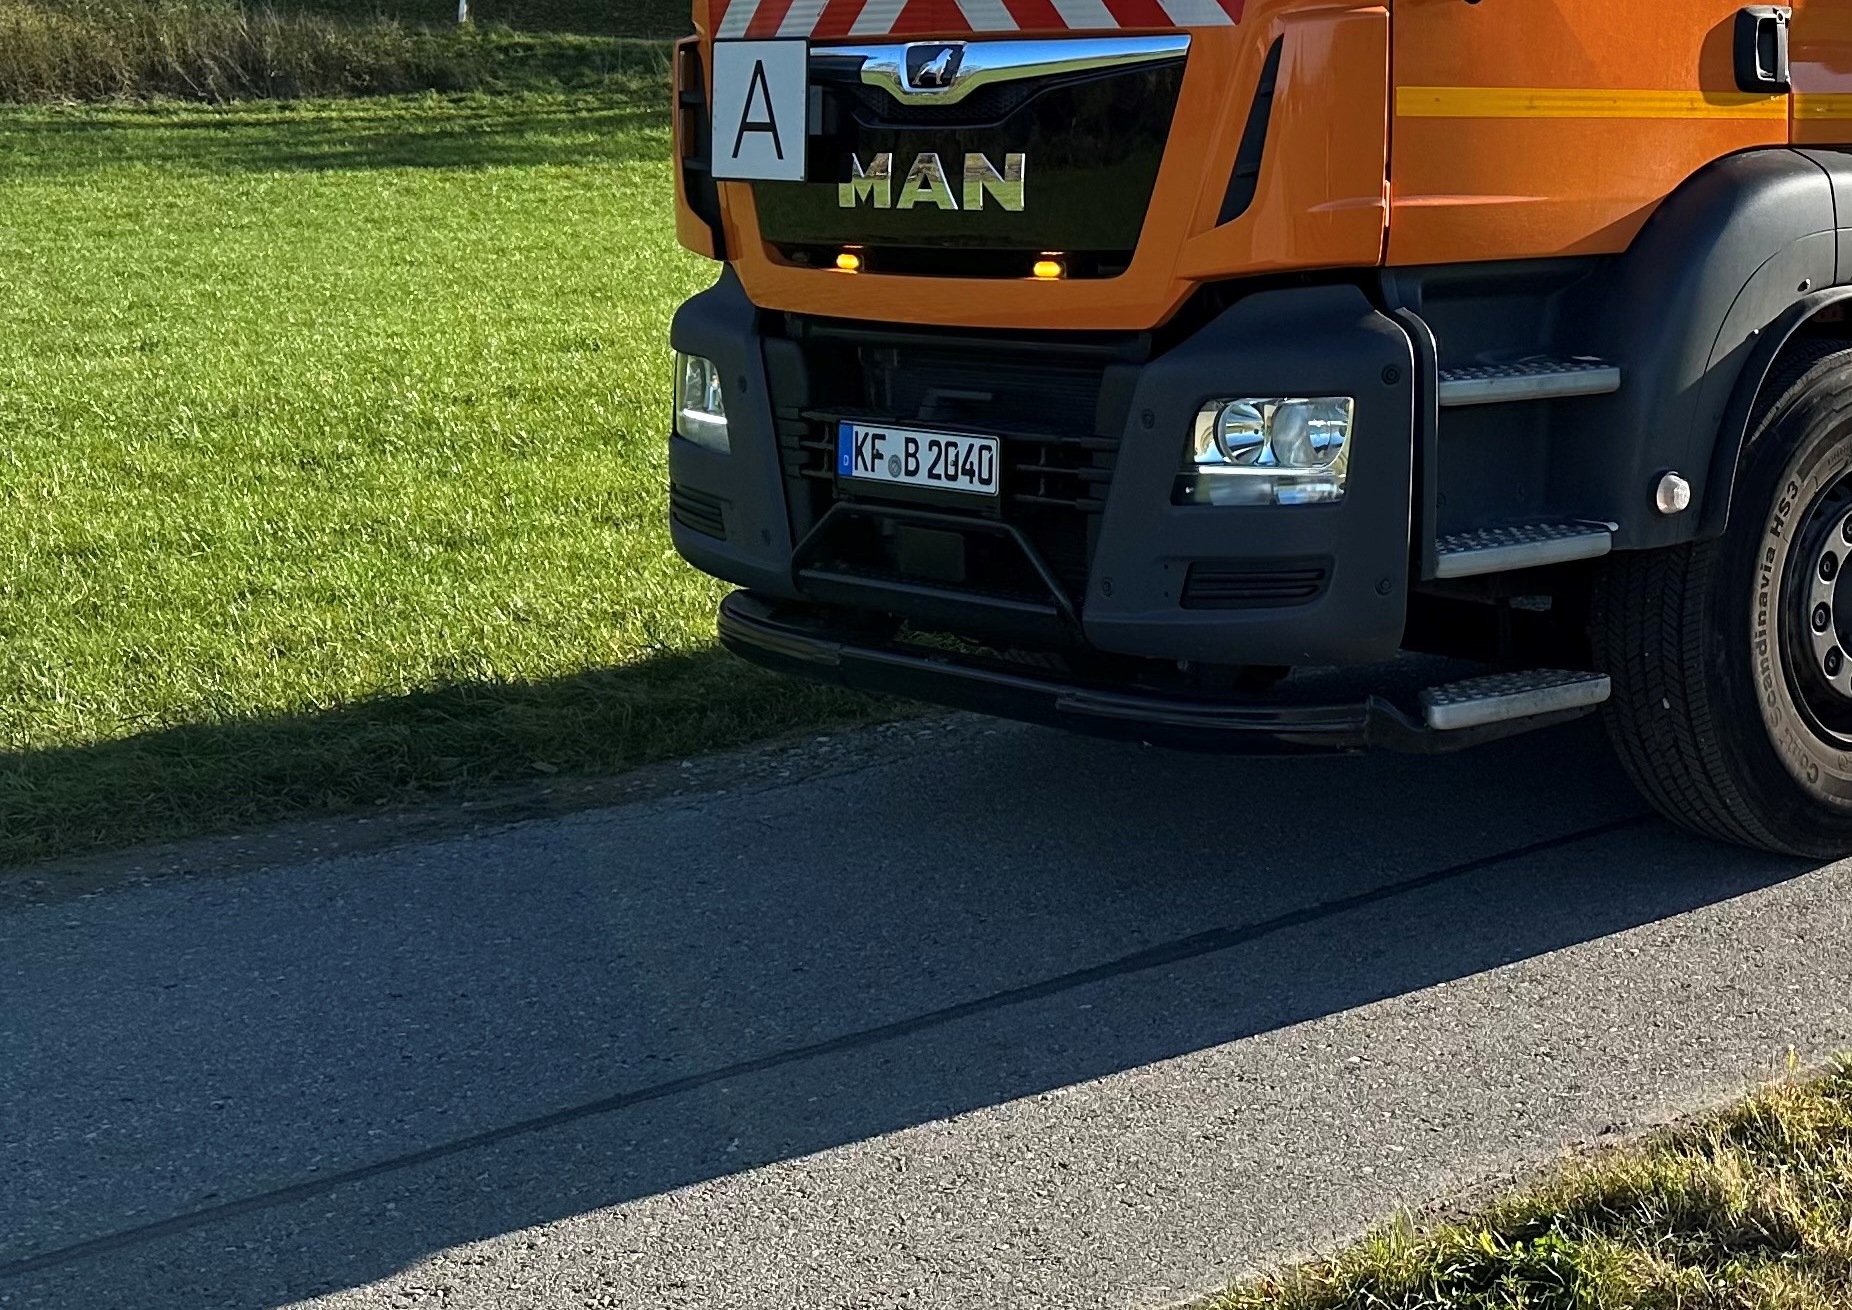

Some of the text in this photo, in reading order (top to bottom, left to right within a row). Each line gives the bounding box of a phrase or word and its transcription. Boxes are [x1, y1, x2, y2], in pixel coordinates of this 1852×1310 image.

[731, 59, 784, 160] A
[838, 152, 1026, 212] MAN
[854, 431, 887, 473] KF
[904, 437, 920, 478] B
[927, 439, 994, 486] 2040
[1754, 545, 1783, 727] Scandinavia
[1769, 480, 1799, 539] HS3
